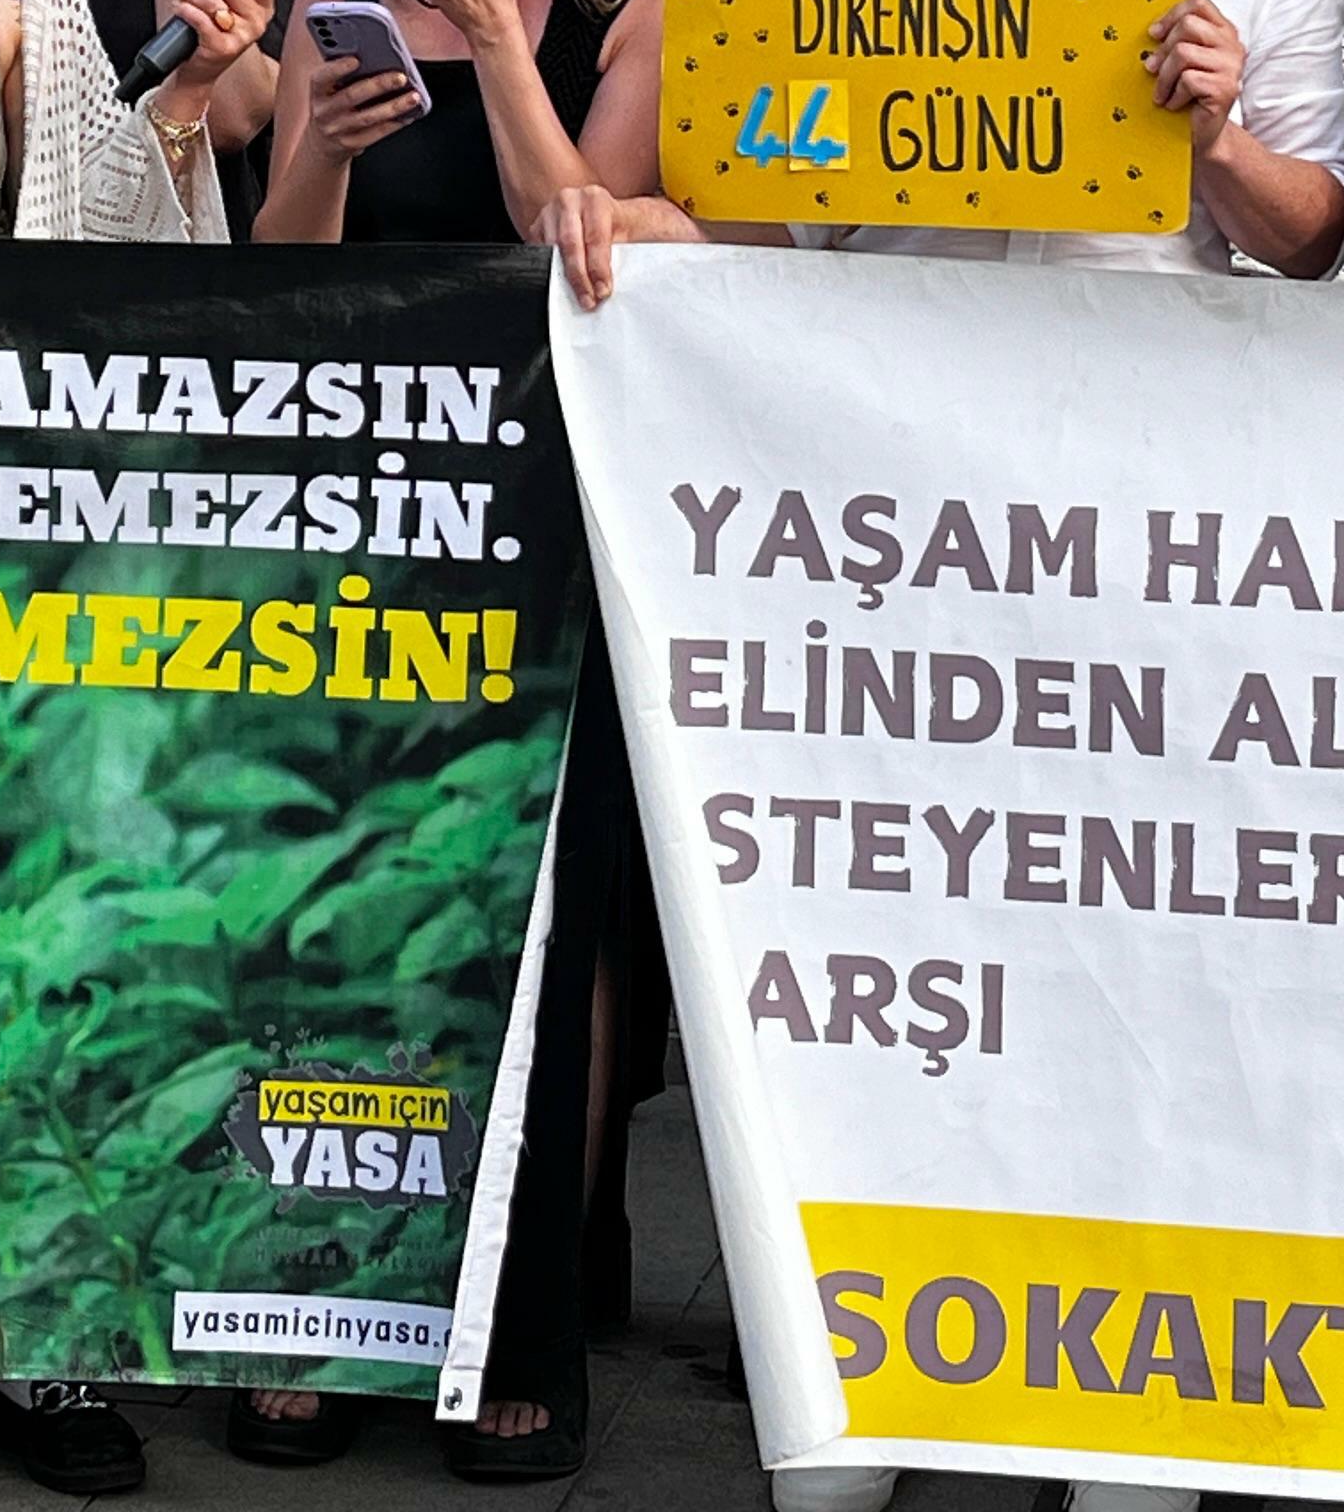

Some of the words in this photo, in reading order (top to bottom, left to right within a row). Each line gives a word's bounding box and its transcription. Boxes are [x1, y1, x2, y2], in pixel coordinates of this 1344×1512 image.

[735, 84, 849, 169] 44
[879, 87, 1064, 173] GÜNÜ
[670, 481, 1100, 610] YAŞAM
[669, 619, 1166, 757] ELİNDEN
[747, 949, 1004, 1077] ARŞI
[264, 1085, 380, 1123] yaşam
[390, 1092, 449, 1128] için
[260, 1126, 448, 1196] YASA
